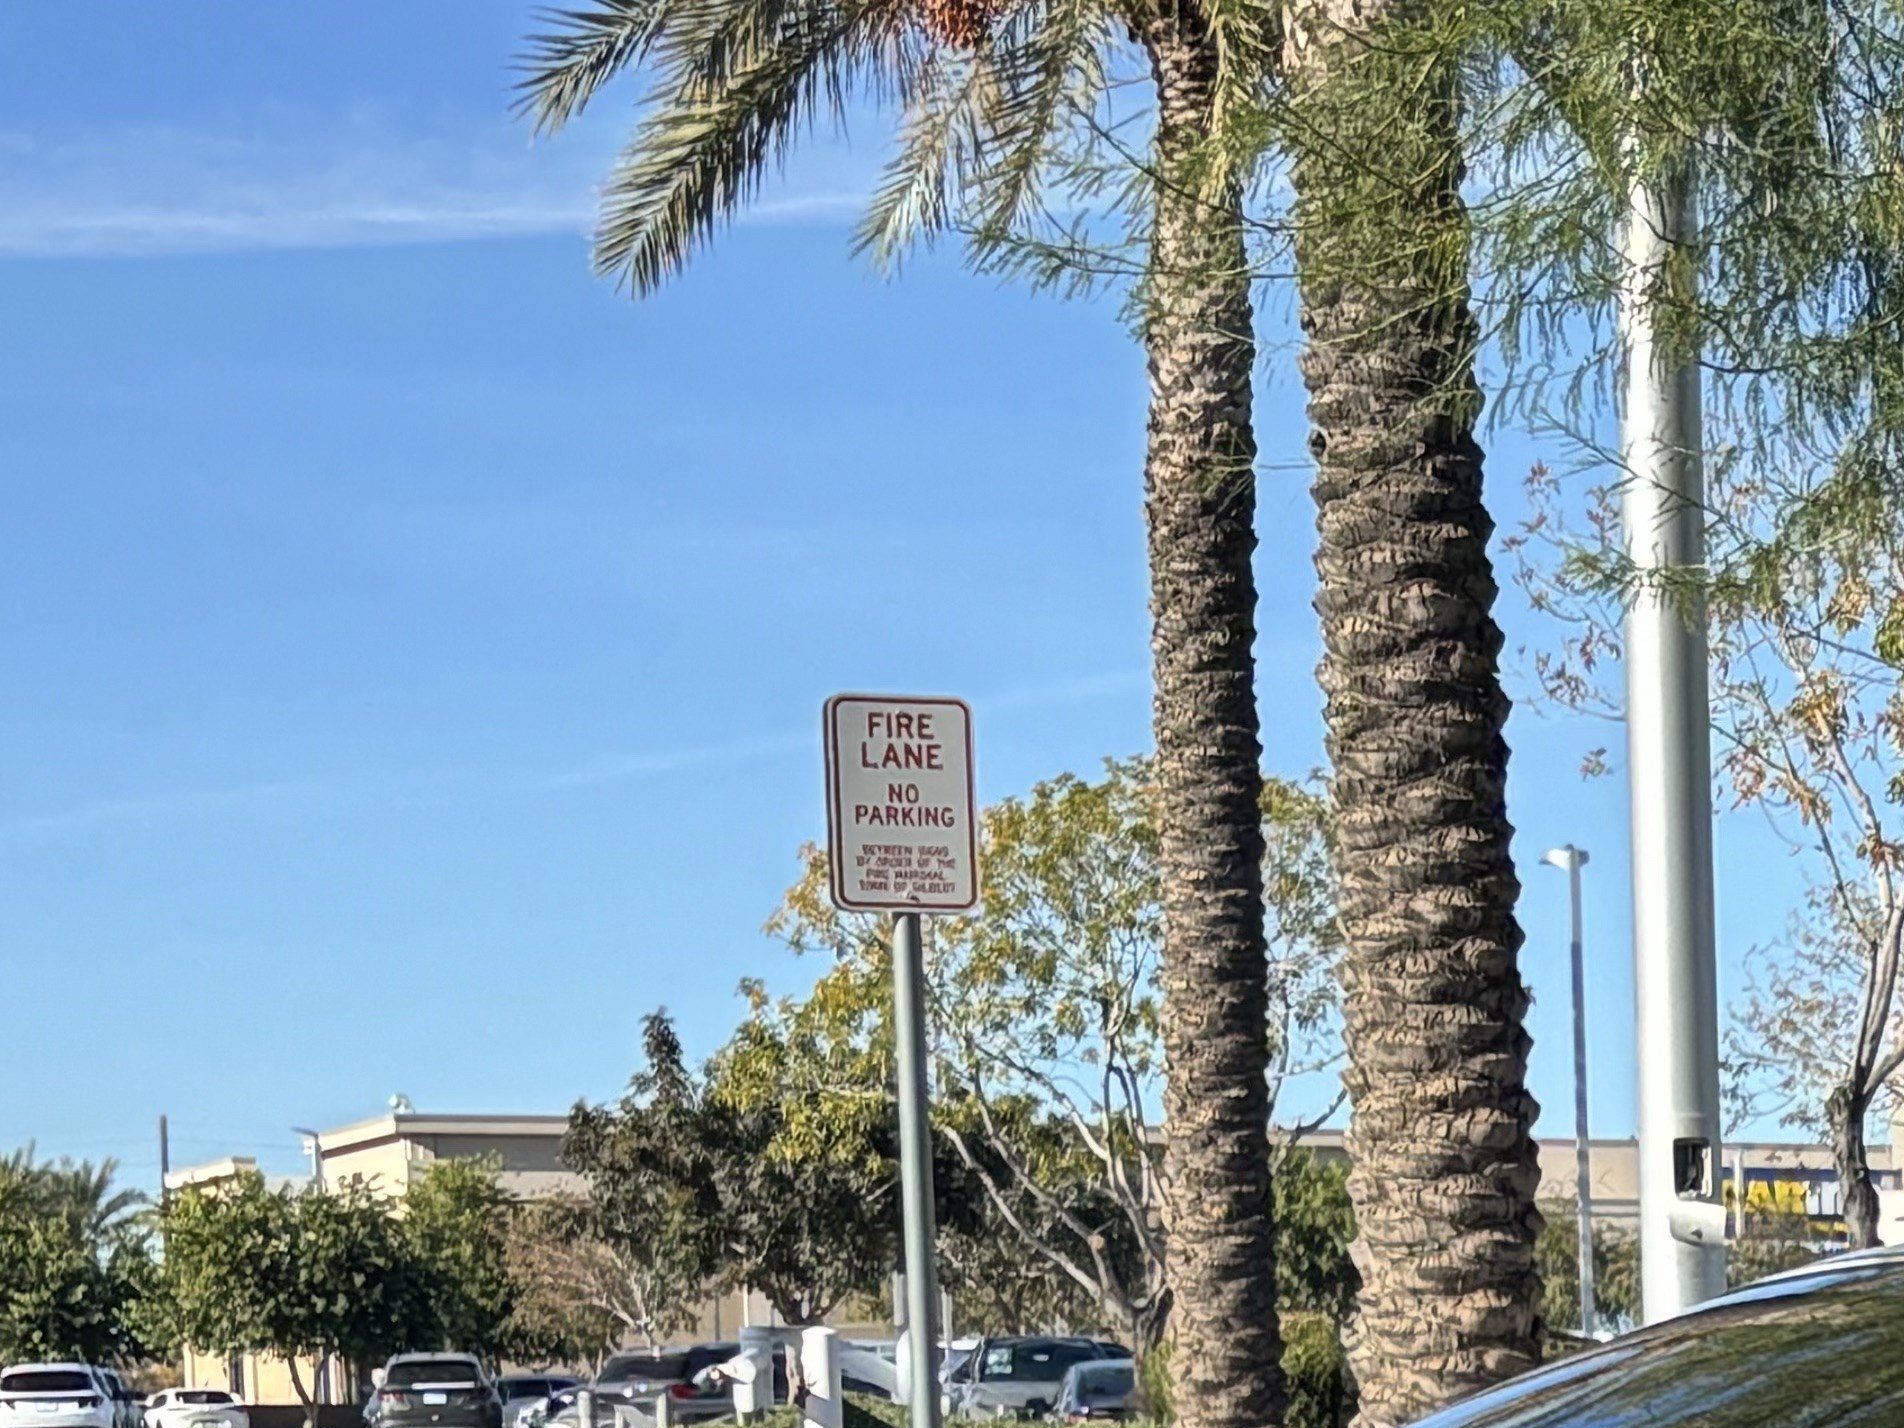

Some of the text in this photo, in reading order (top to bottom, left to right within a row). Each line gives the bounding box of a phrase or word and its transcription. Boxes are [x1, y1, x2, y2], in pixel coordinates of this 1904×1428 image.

[867, 711, 935, 740] FIRE
[861, 741, 944, 770] LANE
[888, 783, 920, 804] NO
[855, 804, 955, 828] PARKING
